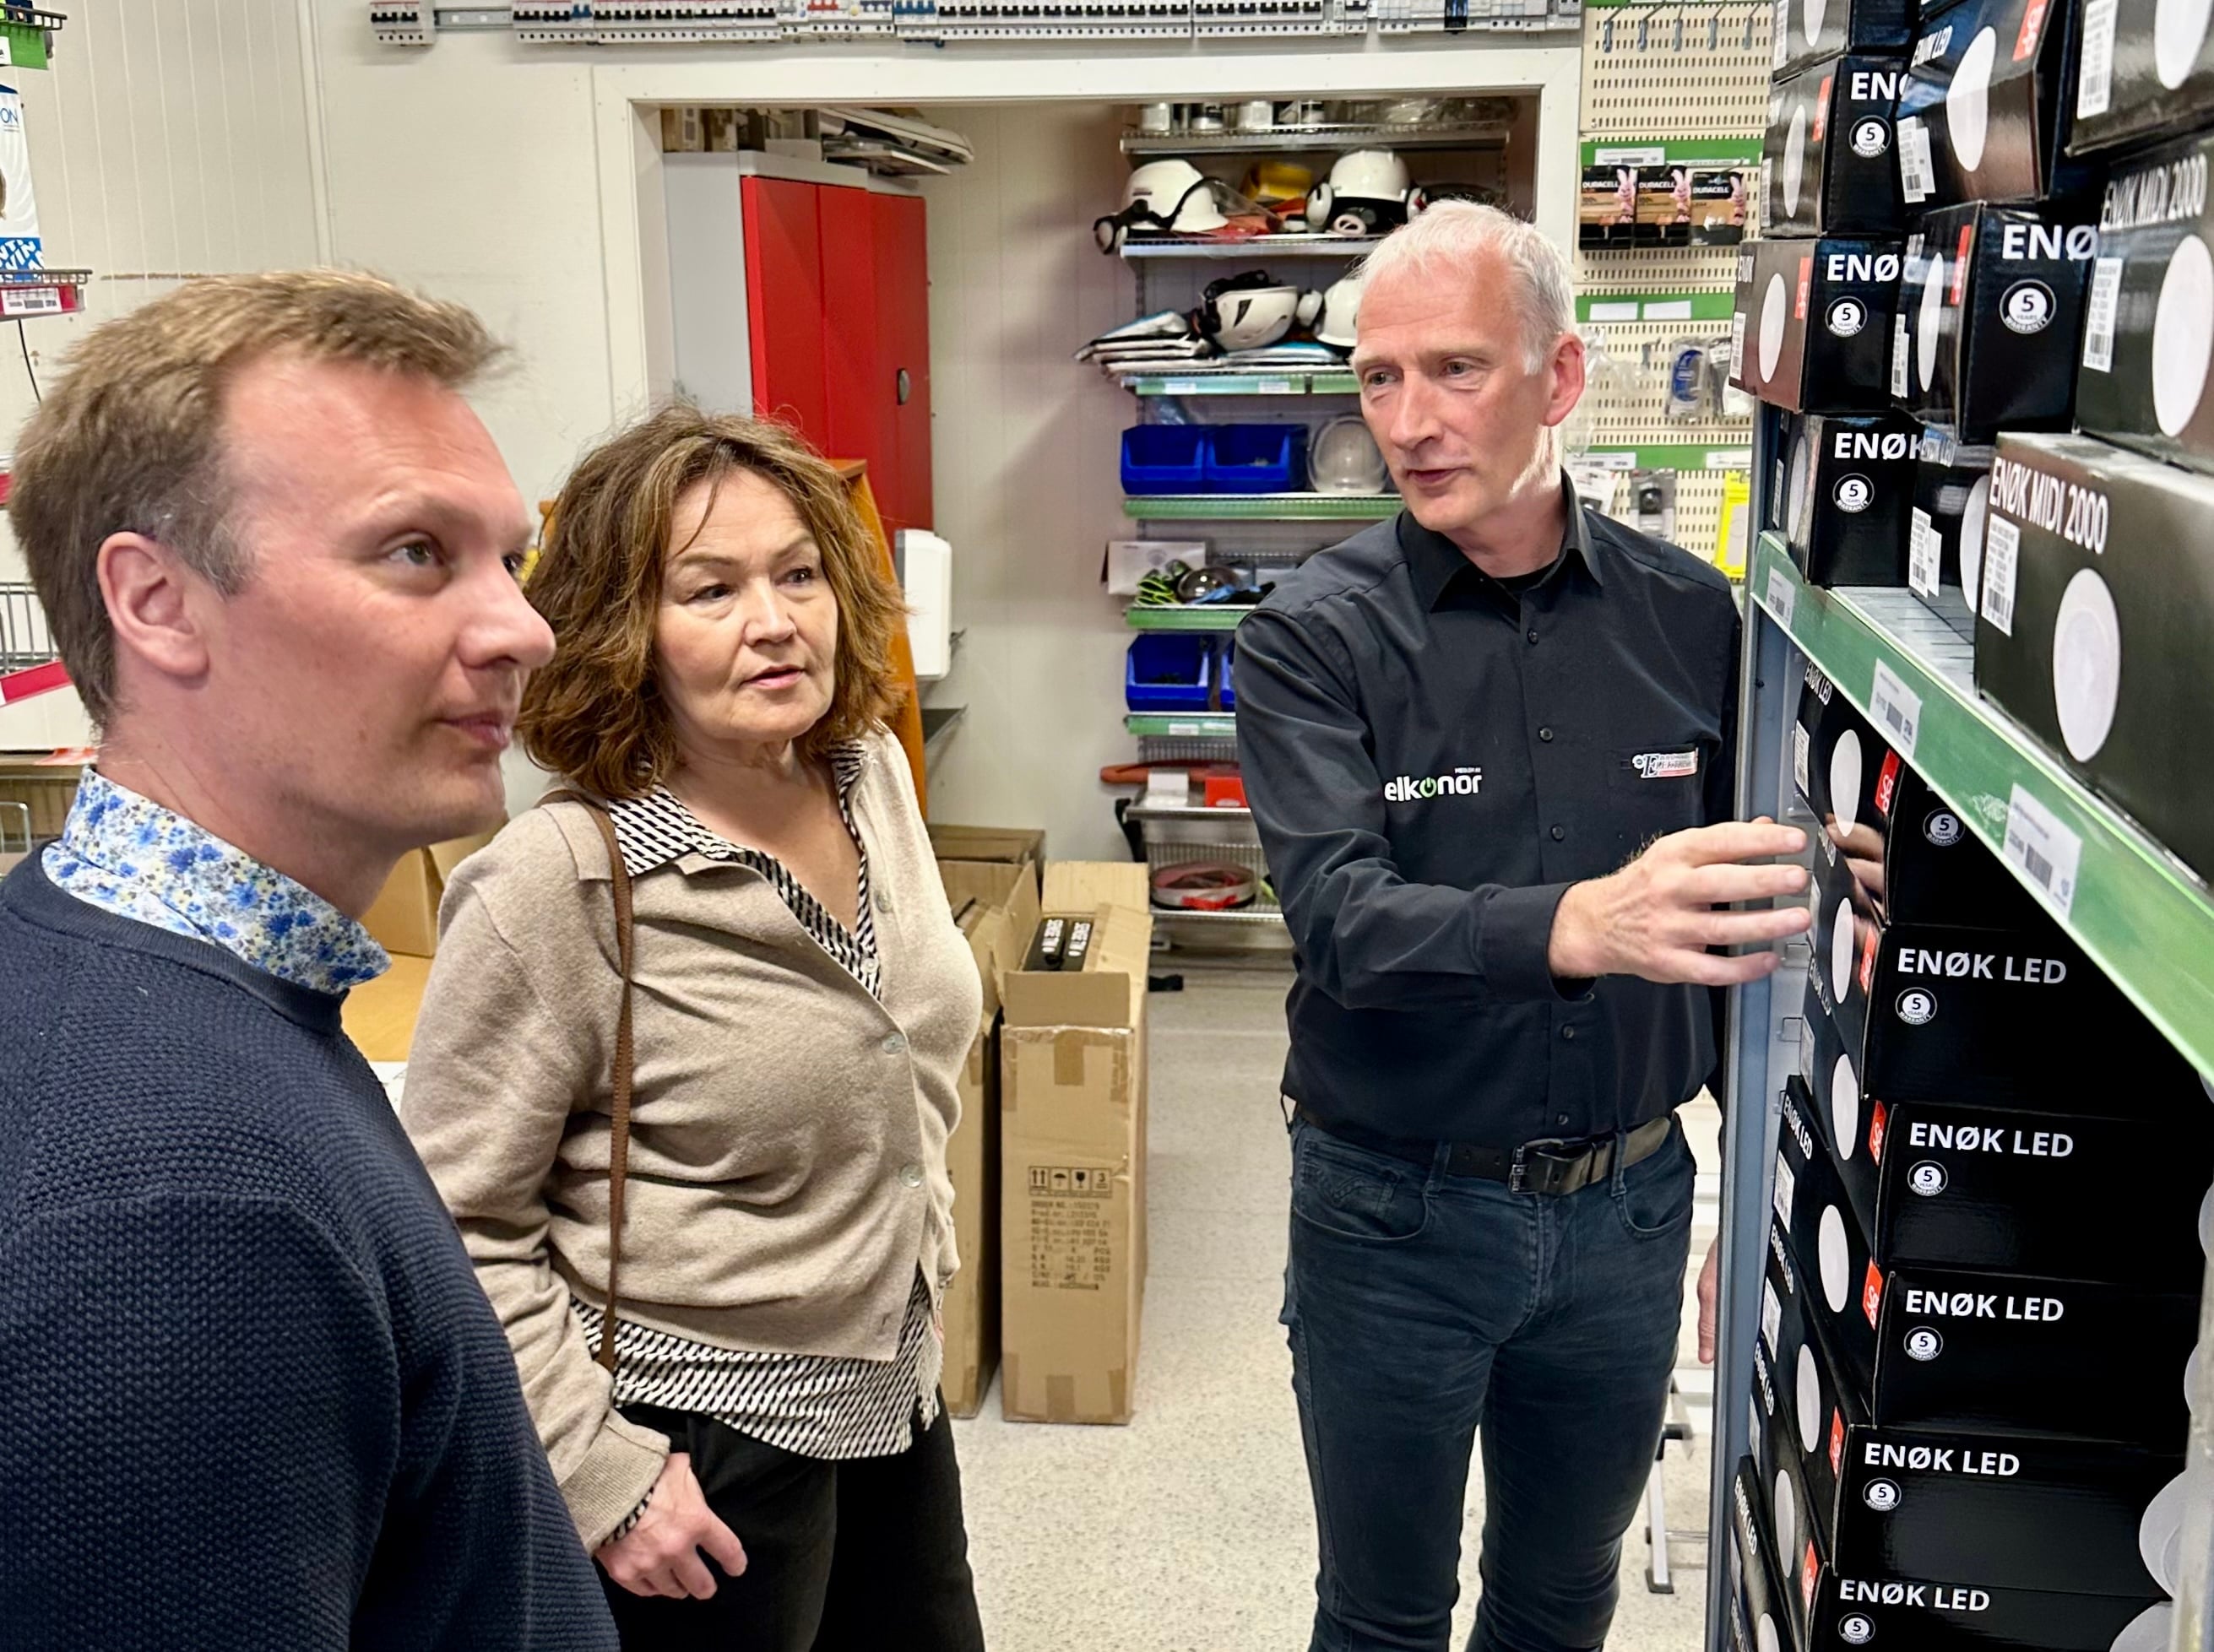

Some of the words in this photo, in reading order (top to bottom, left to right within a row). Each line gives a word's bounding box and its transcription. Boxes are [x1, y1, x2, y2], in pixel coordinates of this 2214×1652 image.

[1865, 127, 1875, 141] 5
[2021, 294, 2034, 312] 5
[1842, 306, 1851, 321] 5
[1848, 484, 1859, 497] 5
[1989, 457, 2032, 519] ENØK
[2028, 470, 2066, 534] MIDI
[2065, 484, 2109, 555] 2000
[1385, 775, 1482, 801] elkonor
[1939, 817, 1950, 831] 5
[1898, 948, 1995, 979] ENØK
[2005, 956, 2067, 983] LED
[1912, 997, 1921, 1010] 5
[1799, 1126, 1813, 1161] LED
[1909, 1122, 2005, 1153] ENØK
[2013, 1131, 2074, 1157] LED
[1923, 1169, 1933, 1182] 5
[1906, 1289, 1997, 1319] ENØK
[2006, 1297, 2064, 1322] LED
[1919, 1335, 1929, 1347] 5
[1864, 1443, 1954, 1471] ENØK
[1963, 1451, 2020, 1476] LED
[1878, 1487, 1887, 1498] 5
[1839, 1579, 1926, 1607] ENØK
[1935, 1588, 1990, 1611] LED
[1853, 1621, 1862, 1633] 5
